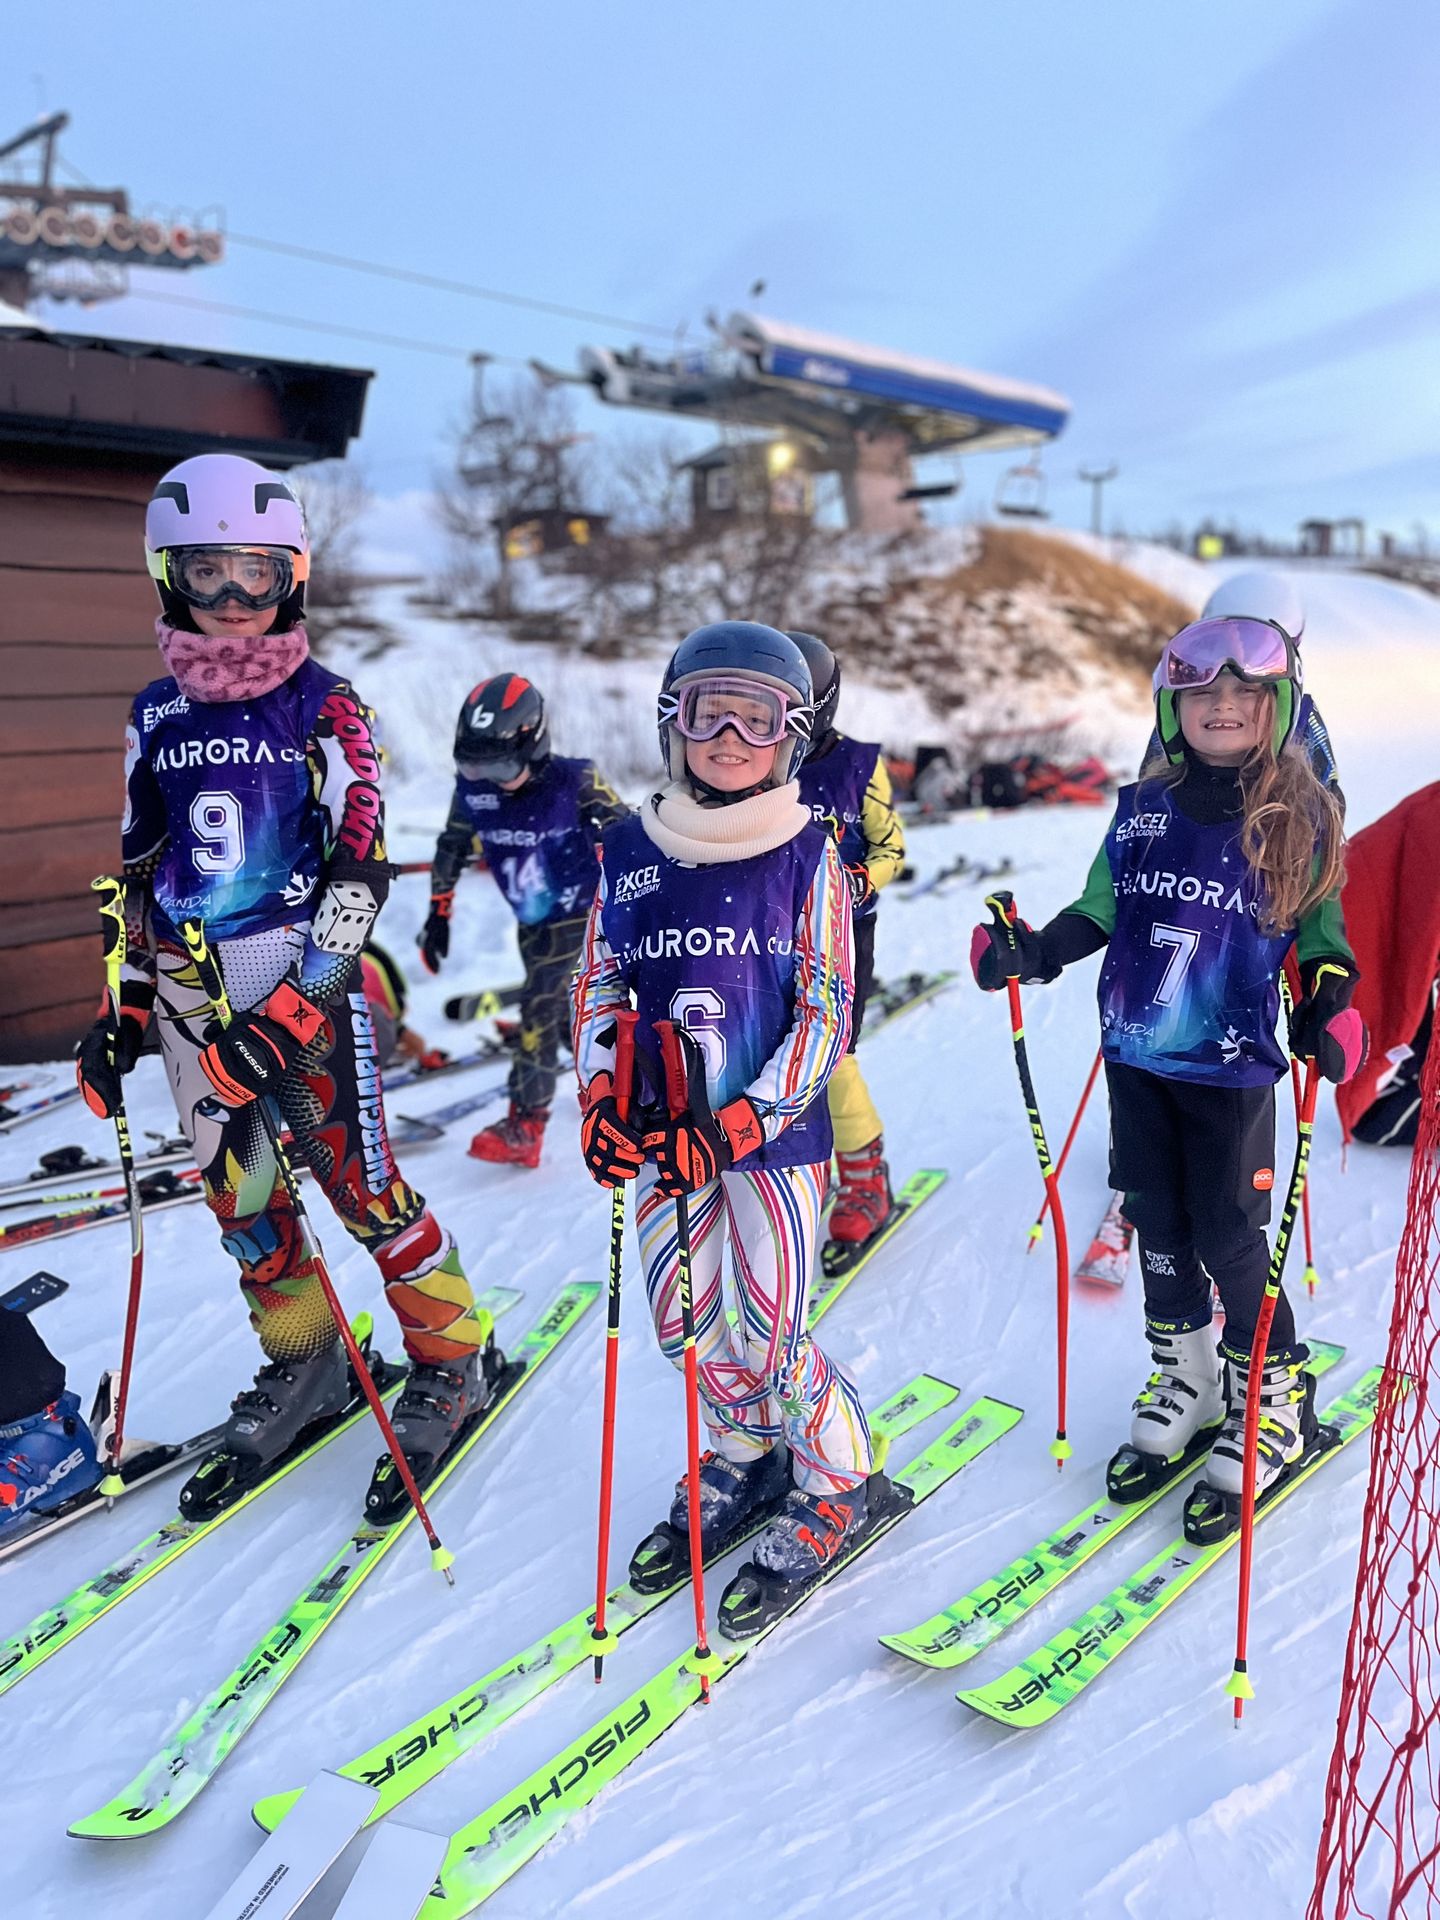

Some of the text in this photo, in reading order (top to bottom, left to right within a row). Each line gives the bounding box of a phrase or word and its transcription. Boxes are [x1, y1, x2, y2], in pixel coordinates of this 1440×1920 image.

[814, 682, 837, 711] SMITH
[156, 737, 275, 773] AURORA
[322, 694, 381, 863] SOLD OUT
[189, 790, 246, 876] 9
[1116, 830, 1135, 843] RACE
[501, 852, 548, 903] 14
[615, 864, 661, 897] EXCEL
[613, 891, 633, 906] RACE
[117, 930, 126, 959] LEKI
[1007, 930, 1016, 950] LEKI
[1149, 921, 1201, 1007] 7
[668, 986, 728, 1082] 6
[234, 1040, 268, 1079] reusch
[225, 1080, 252, 1100] racing
[603, 1125, 629, 1148] racing
[694, 1157, 705, 1187] reusch
[612, 1187, 625, 1231] EKI
[1150, 1258, 1170, 1268] GIA
[10, 1447, 86, 1513] LANGE
[1120, 1472, 1147, 1488] FISCHER
[1199, 1513, 1227, 1528] FISCHER
[996, 1608, 1126, 1713] FISCHER
[257, 1863, 286, 1896] ENGINEERED
[252, 1895, 261, 1903] IN
